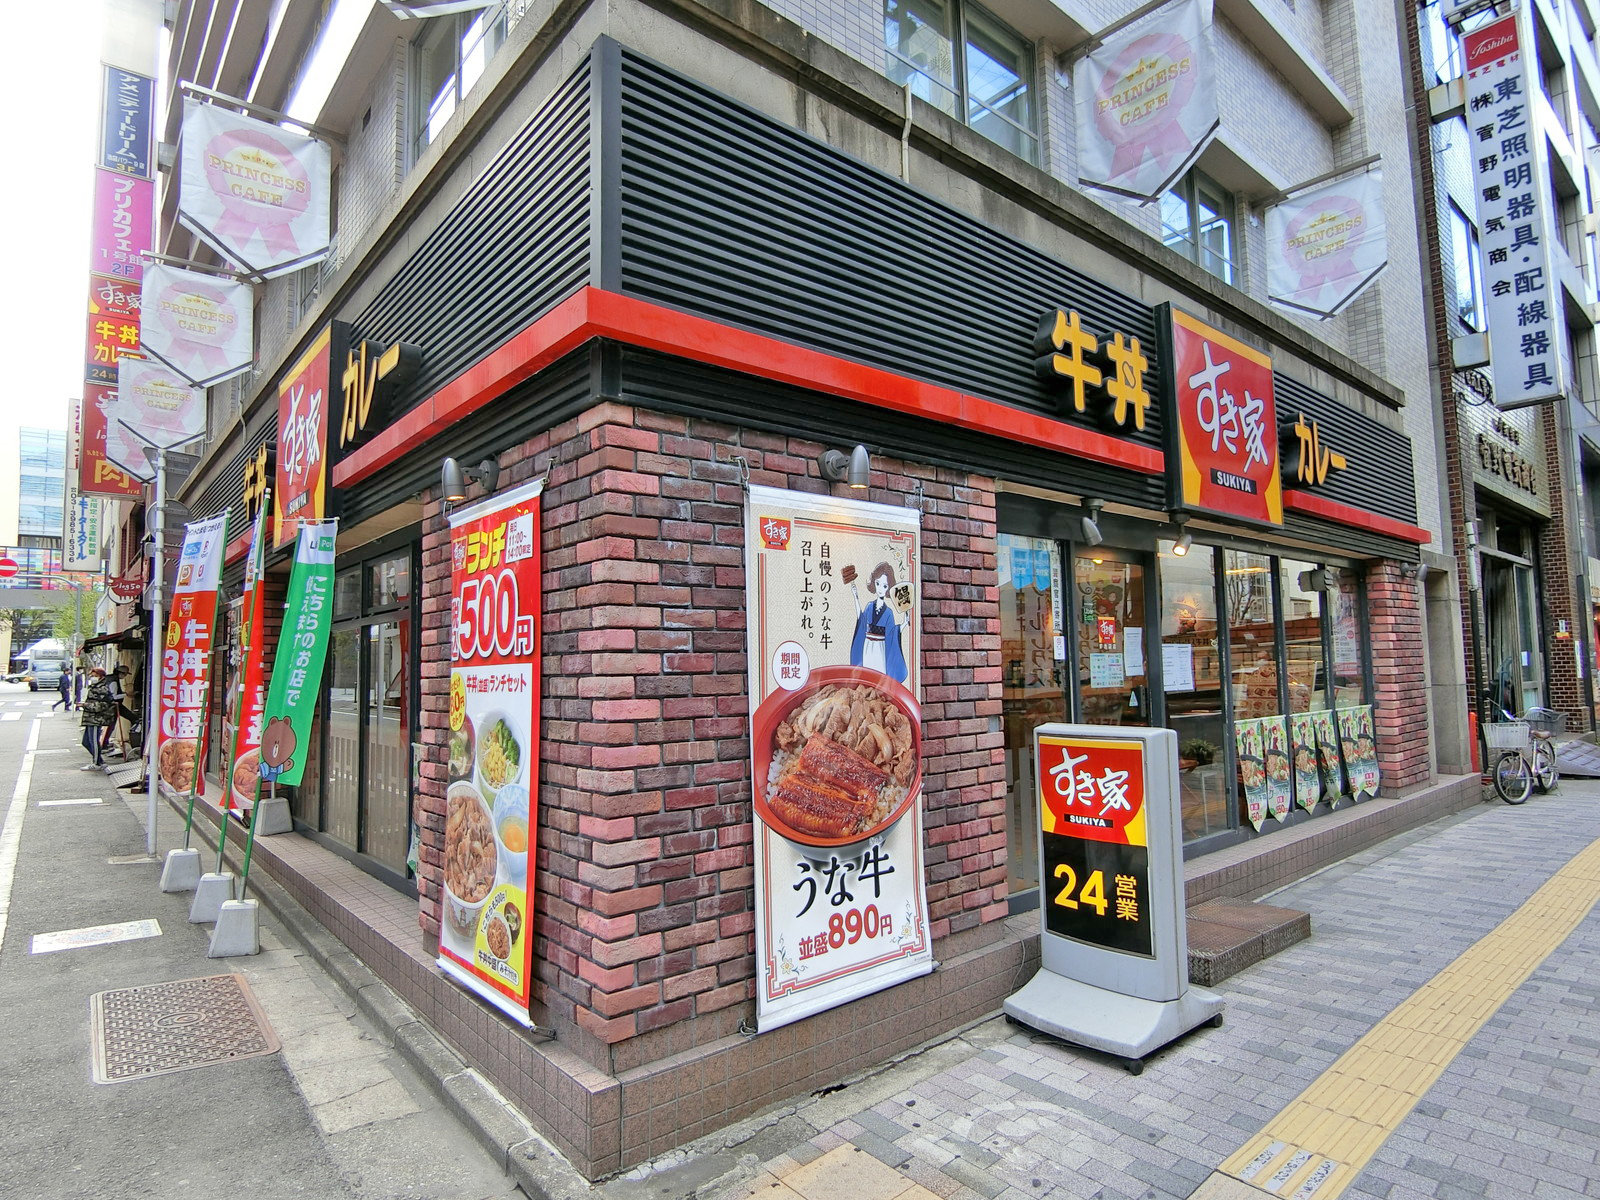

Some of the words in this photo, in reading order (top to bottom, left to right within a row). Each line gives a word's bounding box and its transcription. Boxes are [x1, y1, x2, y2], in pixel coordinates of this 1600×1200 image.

[1469, 34, 1514, 60] Toshiba
[1468, 53, 1520, 81] 東芝電材
[1098, 57, 1191, 115] PRINCESS
[1119, 92, 1169, 127] CAFE
[117, 162, 137, 173] 3F
[208, 155, 307, 194] PRINCESS
[231, 183, 283, 207] CAFE
[112, 178, 135, 251] プリカフェ
[1494, 74, 1553, 390] 東芝照明器具・配線器具
[1286, 215, 1363, 251] PRINCESS
[1304, 239, 1345, 261] CAFE
[101, 248, 144, 266] 1号館
[111, 262, 135, 275] 2F
[97, 280, 142, 311] すき家
[161, 301, 234, 325] PRINCESS
[95, 320, 140, 345] 牛丼
[178, 318, 217, 335] CAFE
[1051, 308, 1151, 432] 牛丼
[132, 386, 192, 402] PRINCESS
[147, 400, 179, 412] CAFE
[340, 340, 401, 449] カレー
[1188, 340, 1269, 473] すき家
[283, 383, 322, 486] すき家
[1294, 411, 1347, 486] カレー
[1216, 470, 1252, 493] SUKIYA
[763, 518, 788, 542] すき家
[467, 521, 507, 575] ランチ
[799, 540, 814, 639] 召し上がれ。
[818, 541, 832, 650] 自慢のうな牛
[894, 584, 911, 607] 鰻
[459, 568, 534, 661] 500円
[287, 575, 328, 707] こちらのお店で
[780, 652, 801, 665] 期間
[177, 619, 209, 739] 牛丼並盛
[780, 665, 801, 680] 限定
[162, 649, 180, 739] 350
[1049, 748, 1132, 816] すき家
[1069, 814, 1107, 827] SUKIYA
[793, 845, 895, 919] うな牛
[1053, 863, 1108, 916] 24
[1114, 873, 1139, 922] 営業
